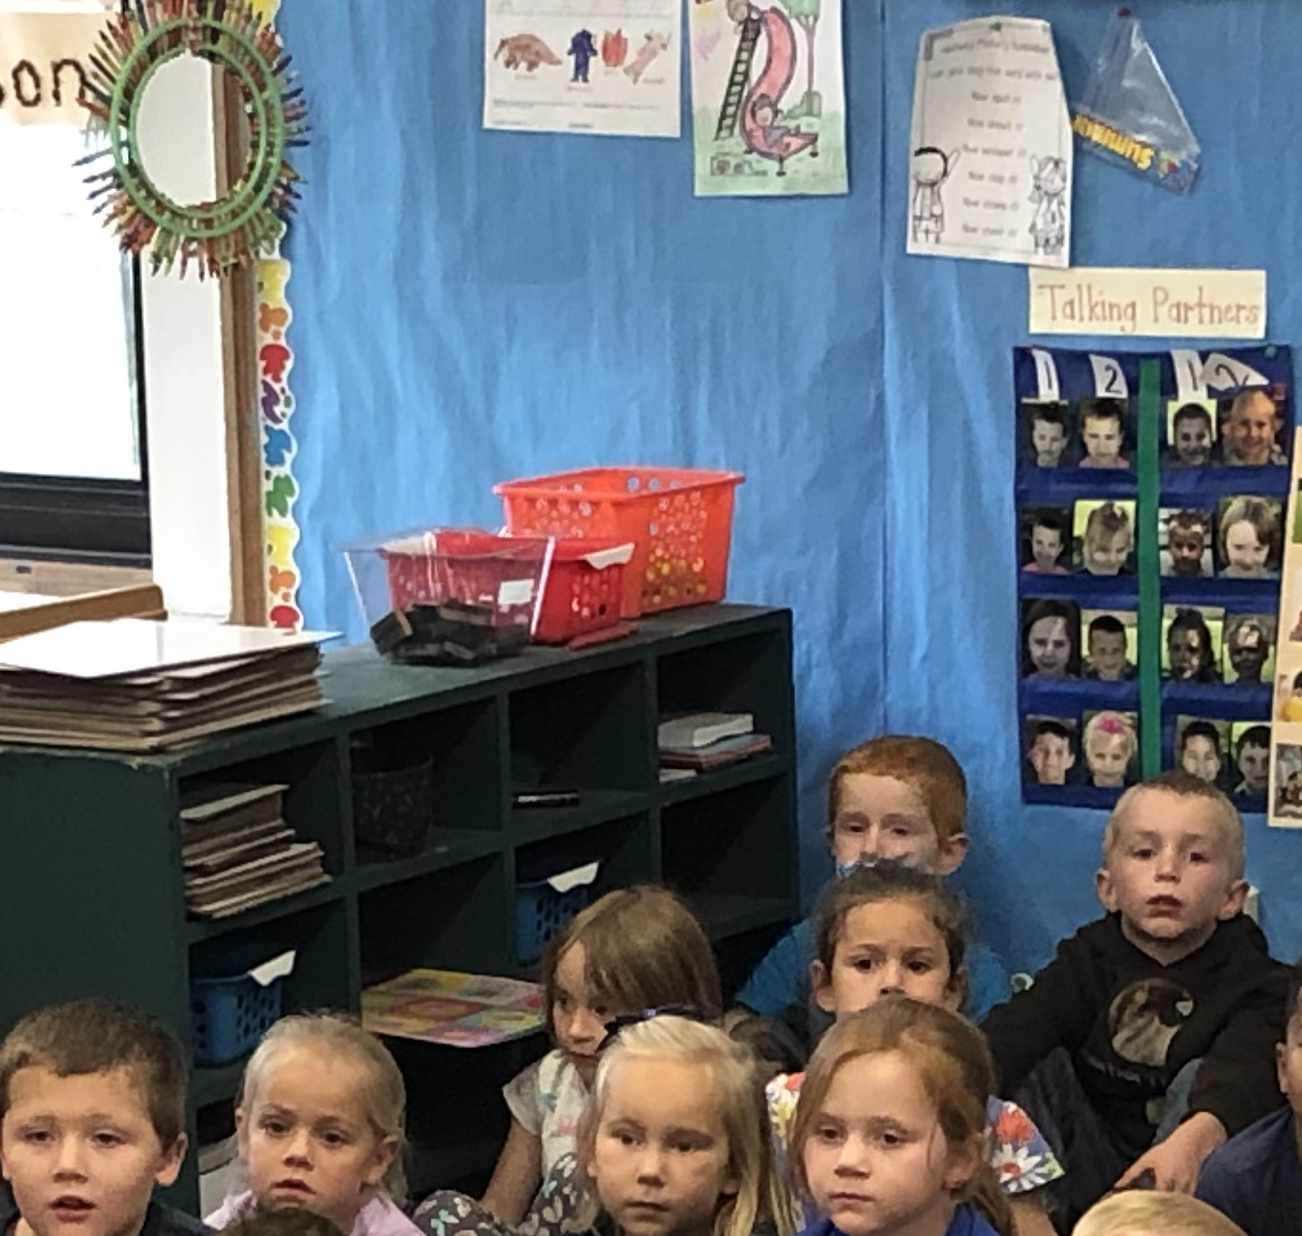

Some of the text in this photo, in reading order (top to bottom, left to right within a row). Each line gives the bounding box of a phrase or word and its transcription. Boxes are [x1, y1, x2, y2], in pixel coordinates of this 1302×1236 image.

[1037, 283, 1260, 332] Talking Partners
[1045, 359, 1198, 394] 1 2 1
